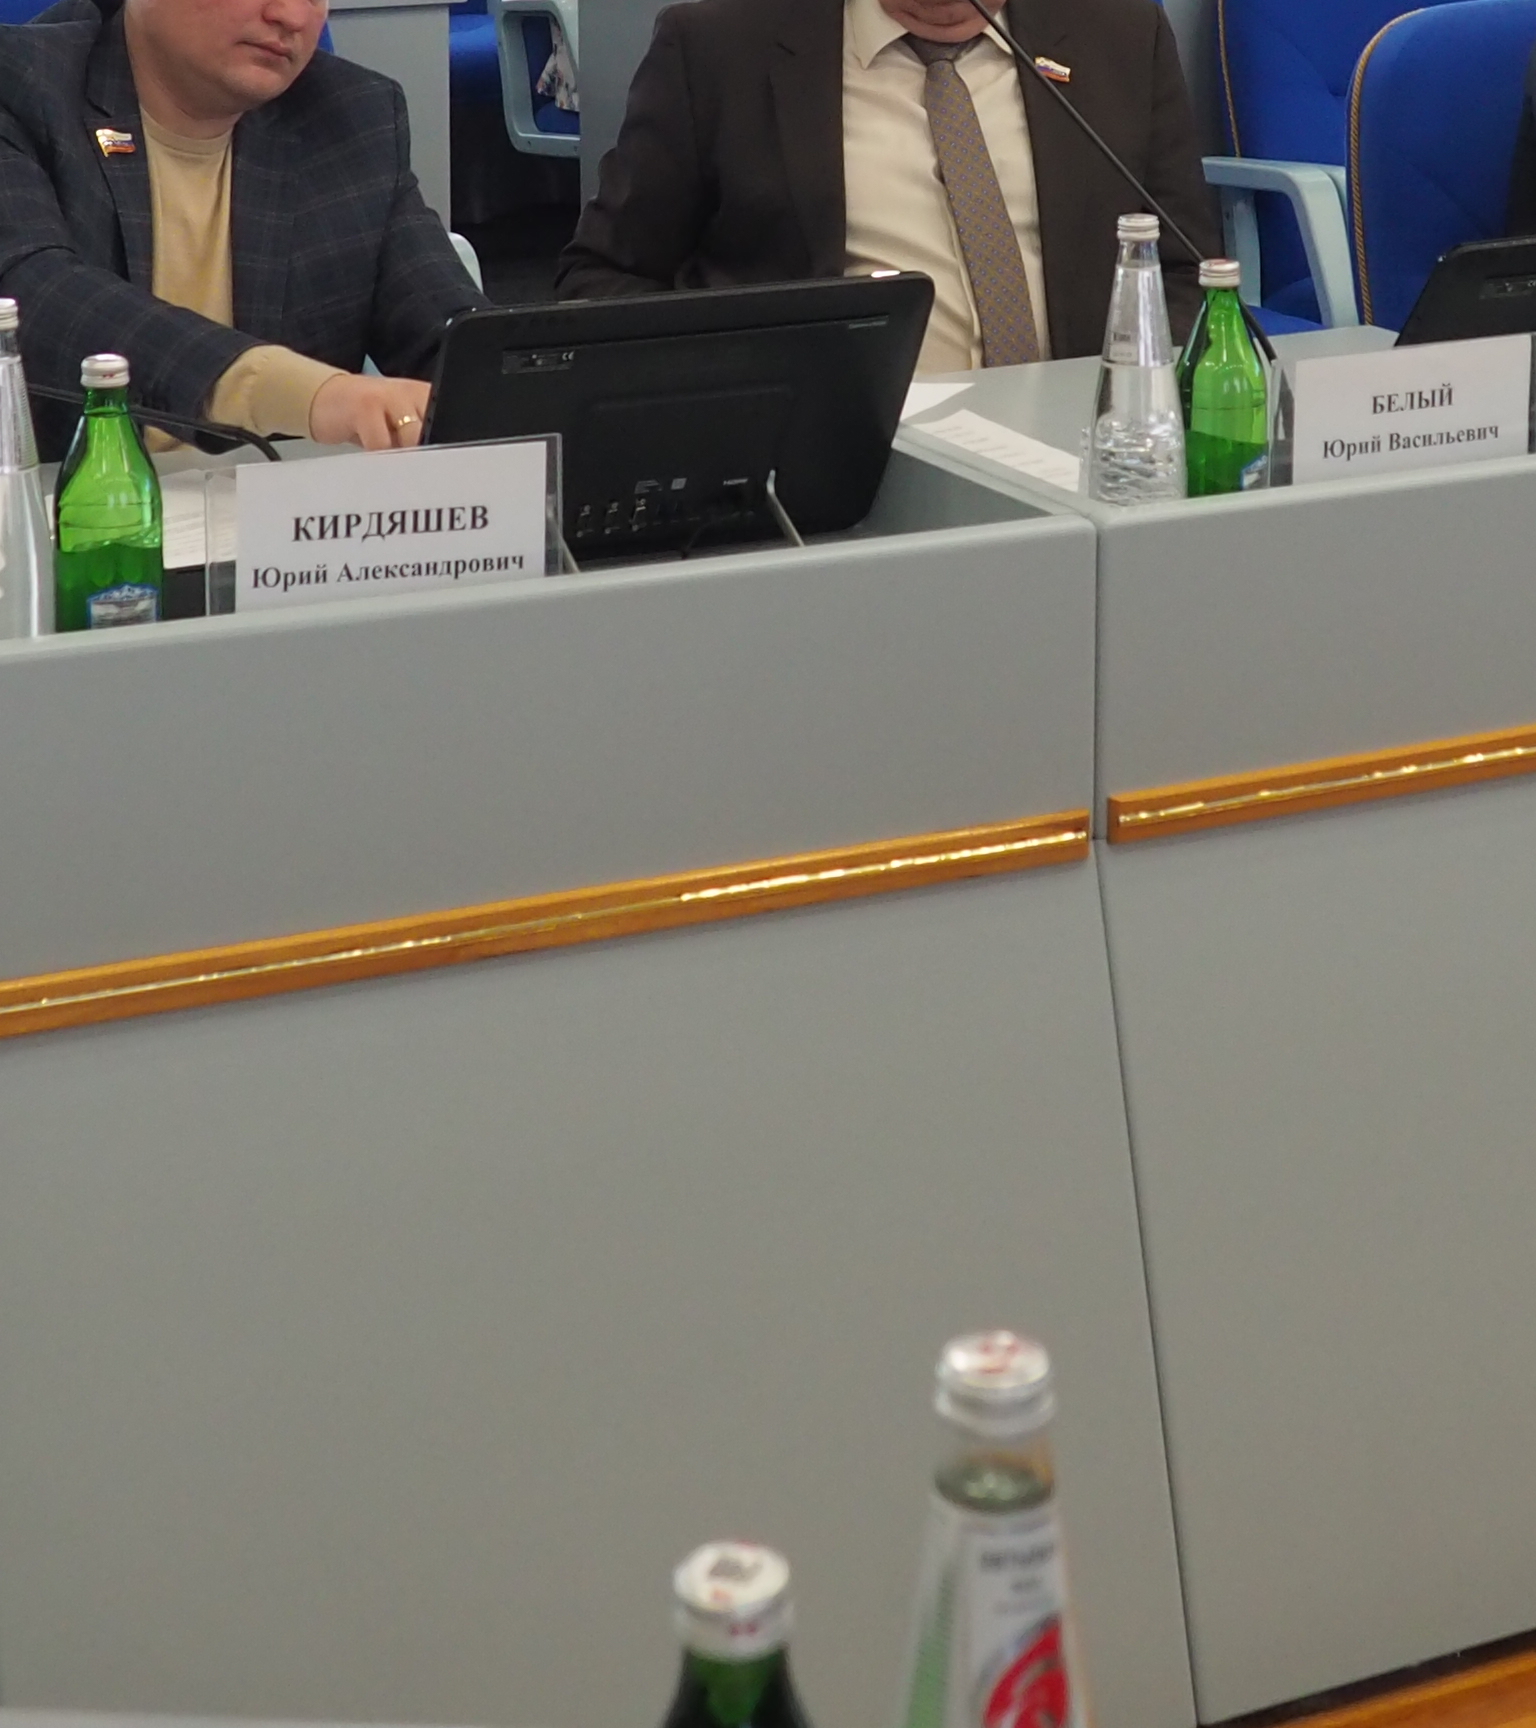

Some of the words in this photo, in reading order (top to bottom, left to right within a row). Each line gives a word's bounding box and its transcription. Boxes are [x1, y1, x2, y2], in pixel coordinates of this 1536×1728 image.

[1372, 383, 1454, 414] БЕЛЫЙ
[1322, 435, 1381, 461] Юрий
[1388, 425, 1499, 451] Васильевич
[291, 505, 490, 542] КИРДЯШЕВ
[252, 563, 328, 592] Юрий
[336, 554, 525, 584] Александрович
